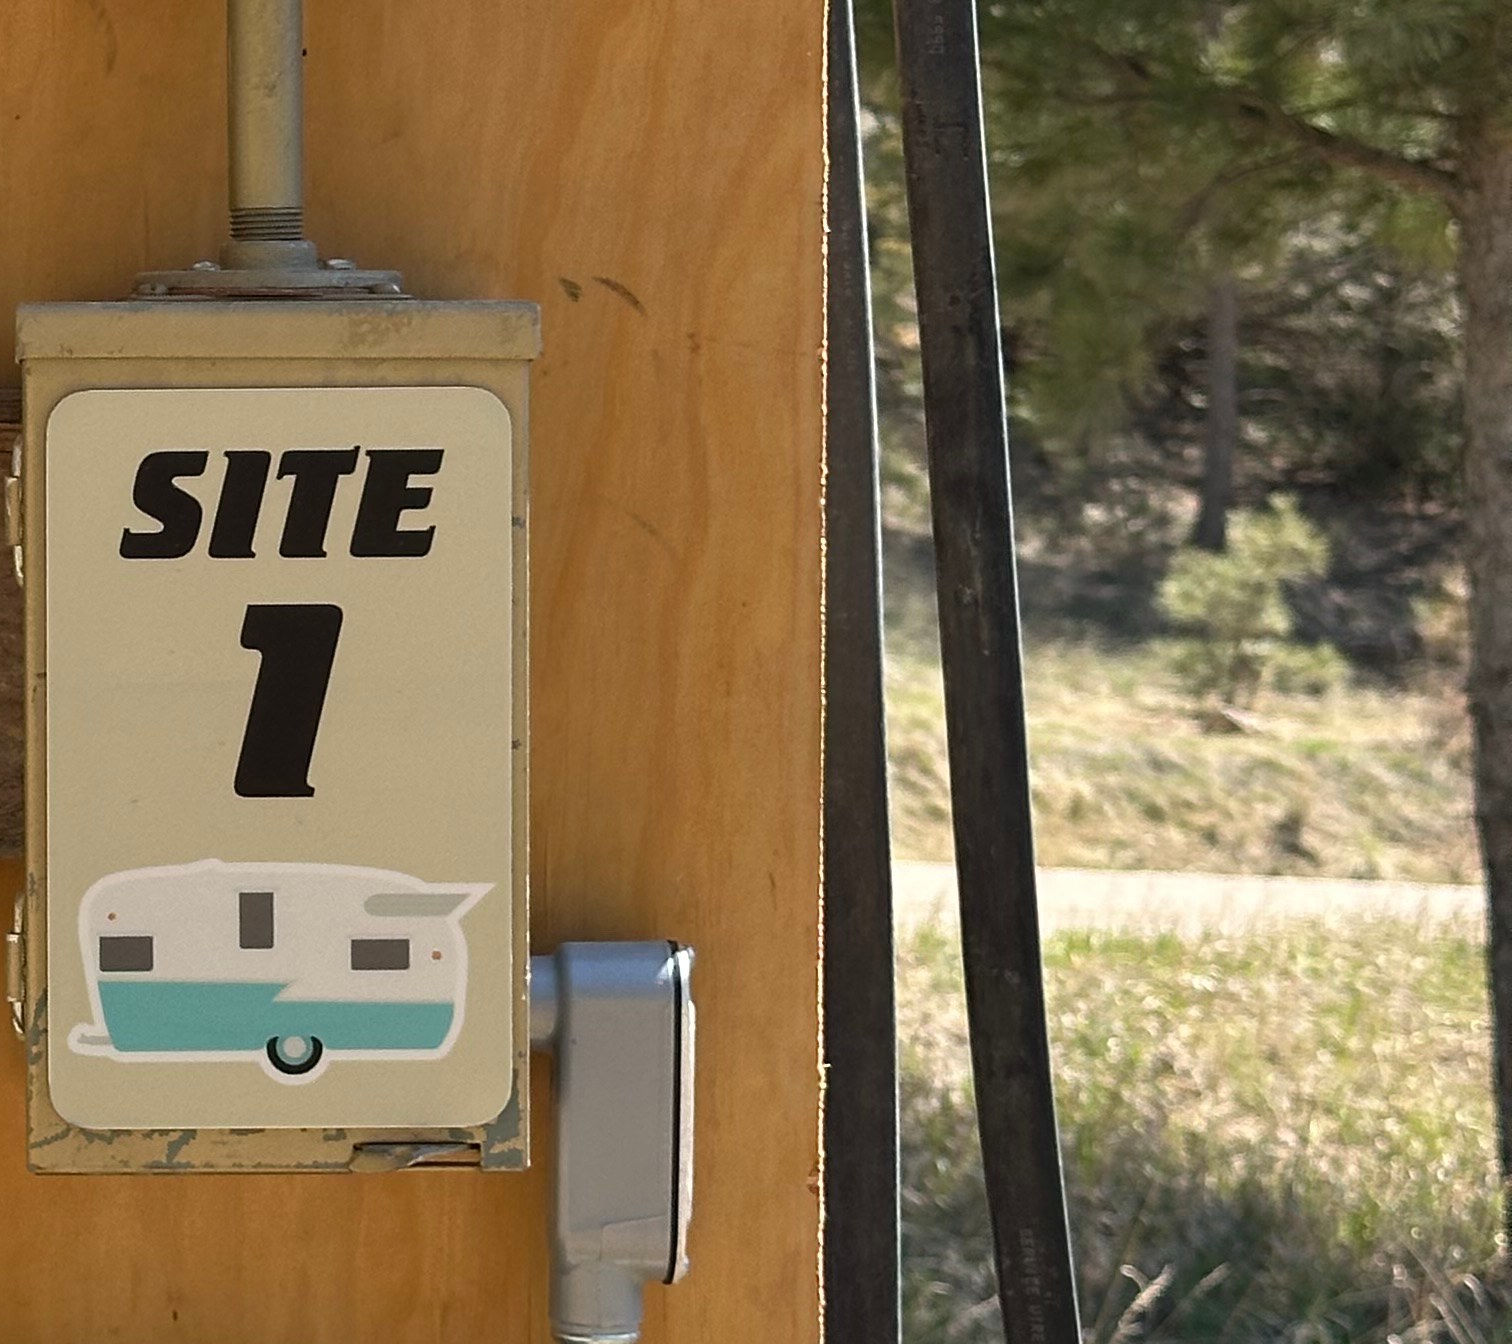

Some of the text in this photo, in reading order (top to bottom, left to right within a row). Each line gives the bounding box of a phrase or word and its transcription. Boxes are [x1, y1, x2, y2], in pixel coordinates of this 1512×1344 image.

[120, 446, 444, 559] SITE
[234, 604, 343, 797] 1
[1027, 1304, 1046, 1343] WIRE
